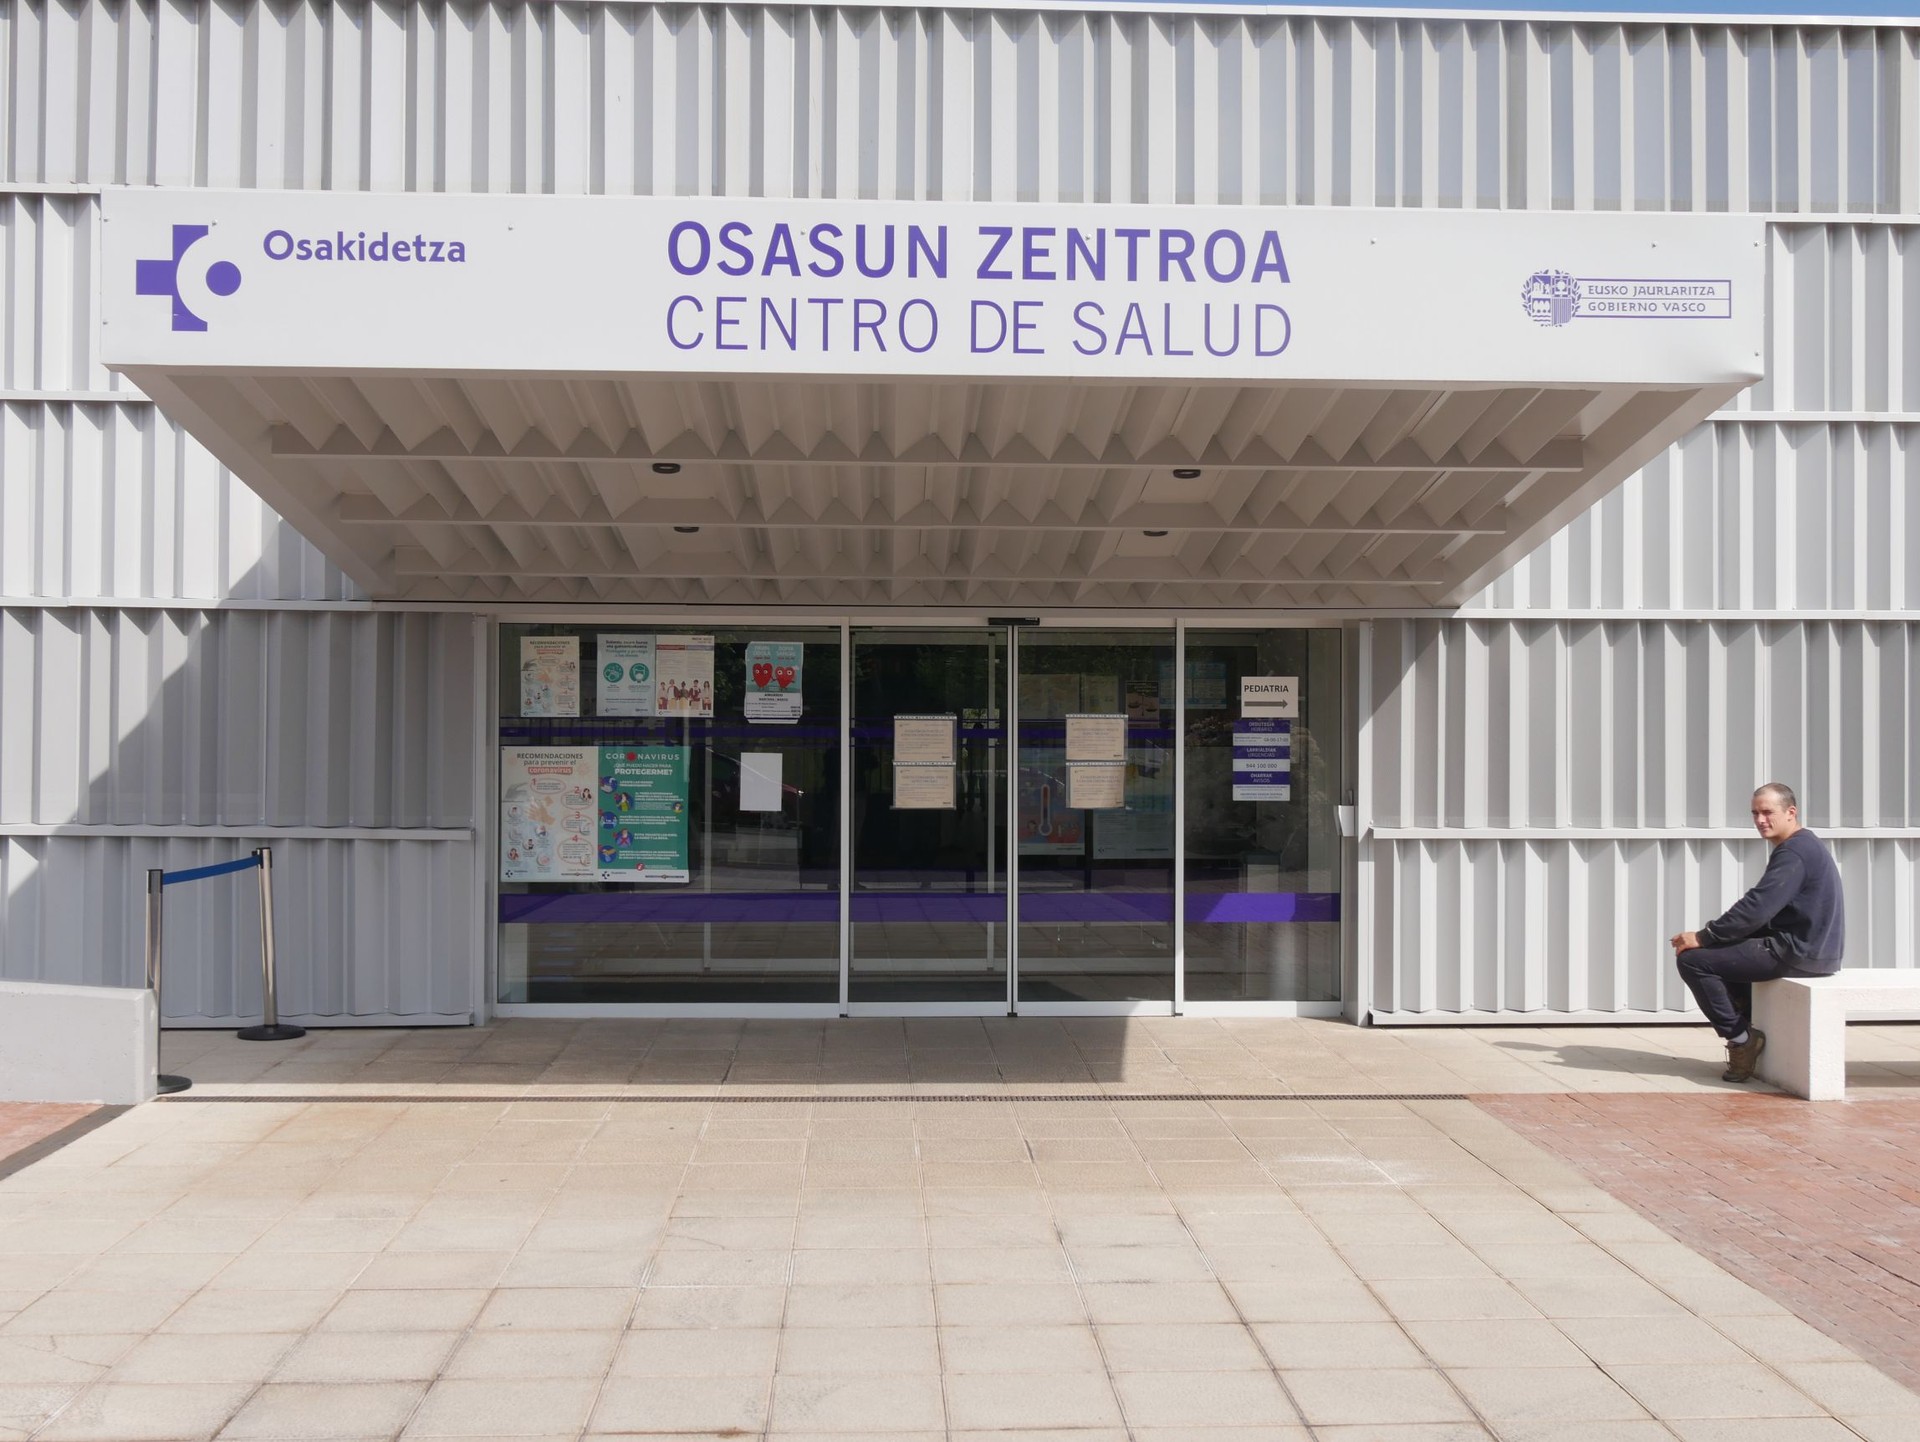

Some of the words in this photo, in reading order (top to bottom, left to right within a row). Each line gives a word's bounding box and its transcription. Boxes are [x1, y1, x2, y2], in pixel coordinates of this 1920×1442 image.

[263, 230, 466, 263] Osakidetza
[667, 220, 948, 279] OSASUN
[976, 226, 1291, 284] ZENTROA
[1589, 285, 1628, 296] EUSKO
[1634, 285, 1715, 298] JAURLARITZA
[1589, 302, 1658, 313] GOBIERNO
[1662, 302, 1707, 313] VASCO
[666, 295, 939, 354] CENTRO
[970, 299, 1045, 355] DE
[1072, 301, 1292, 357] SALUD
[1244, 684, 1289, 693] PEDIATRIA
[614, 768, 673, 776] PROTEGERME?
